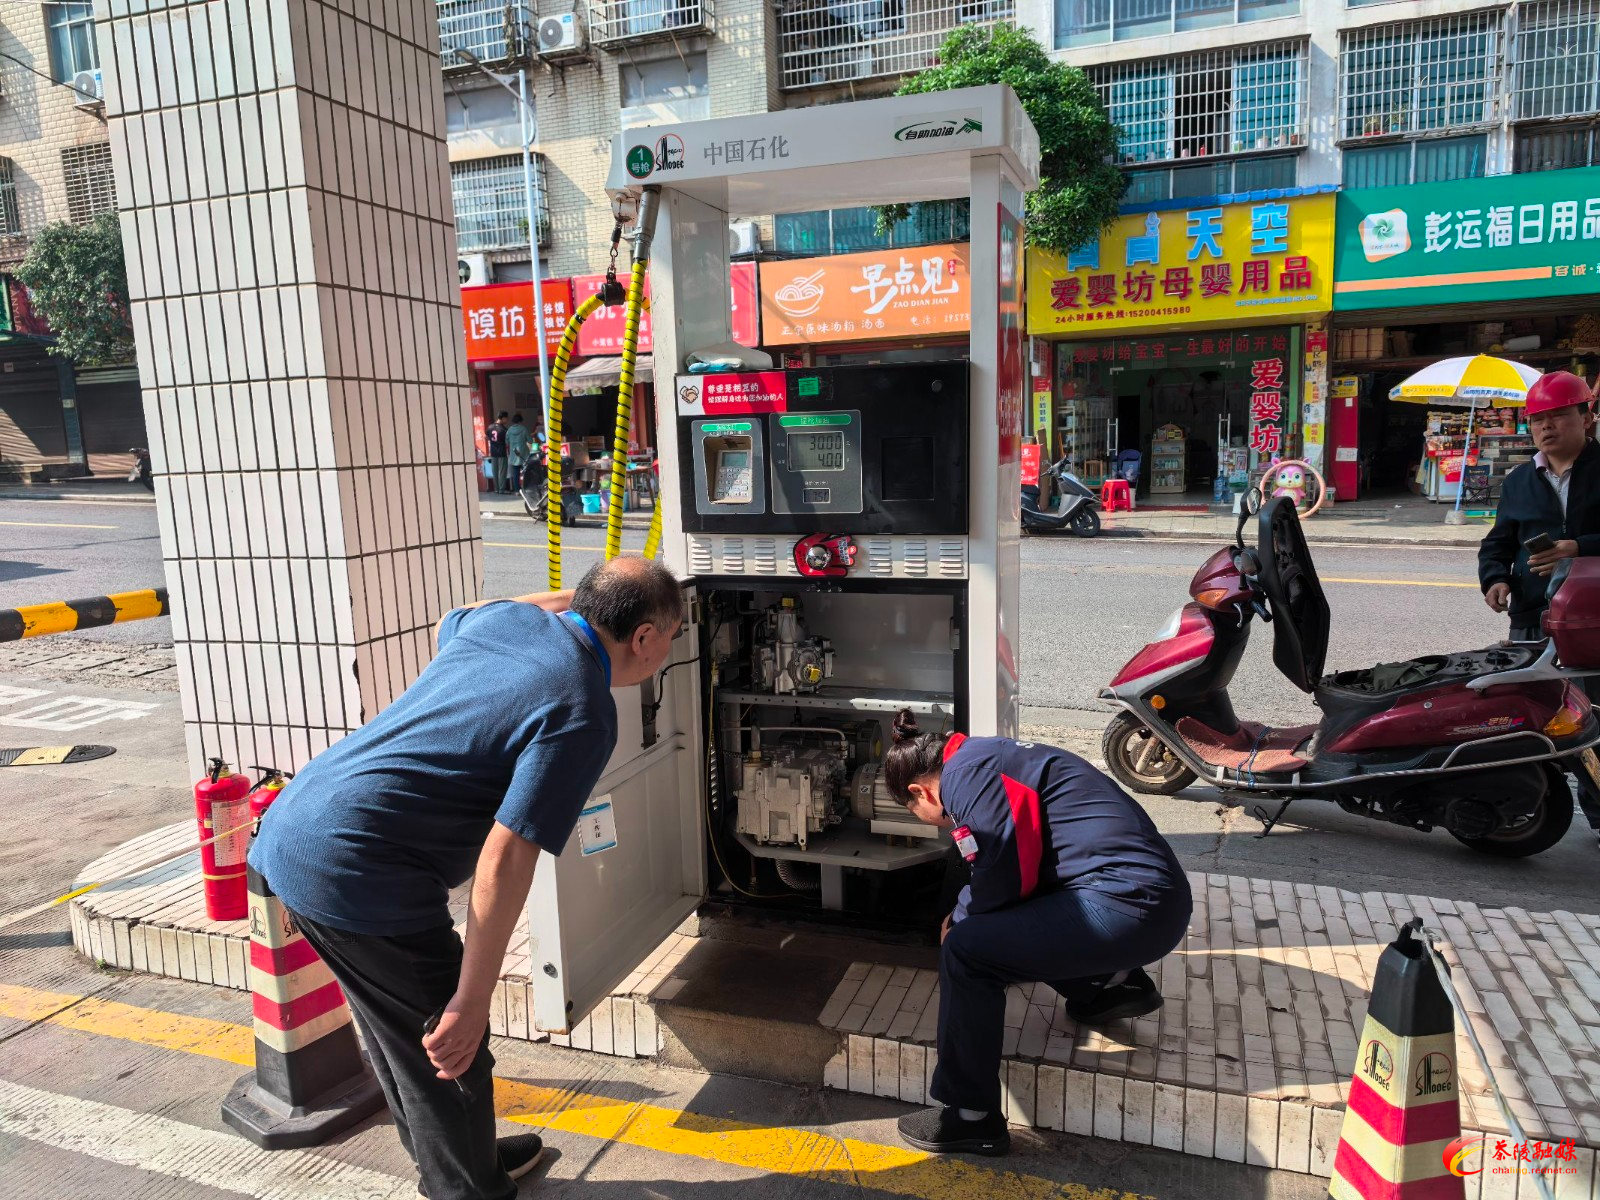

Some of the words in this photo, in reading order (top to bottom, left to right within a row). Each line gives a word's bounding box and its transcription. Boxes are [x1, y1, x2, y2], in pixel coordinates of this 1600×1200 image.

[905, 126, 955, 140] 自助加油
[637, 148, 644, 161] 1
[704, 136, 790, 165] 中国石化
[632, 162, 650, 173] 号枪
[1423, 198, 1600, 254] 彭运福日用品
[850, 256, 960, 315] 早点见
[1050, 255, 1313, 311] 爱婴坊母婴用品
[911, 299, 931, 307] DIAN
[932, 297, 949, 305] JIAN
[1072, 335, 1289, 363] 爱婴坊给宝宝一生最好的开始
[1250, 357, 1283, 454] 爱婴坊
[491, 430, 498, 442] 3
[1415, 1053, 1452, 1097] SINOPEC
